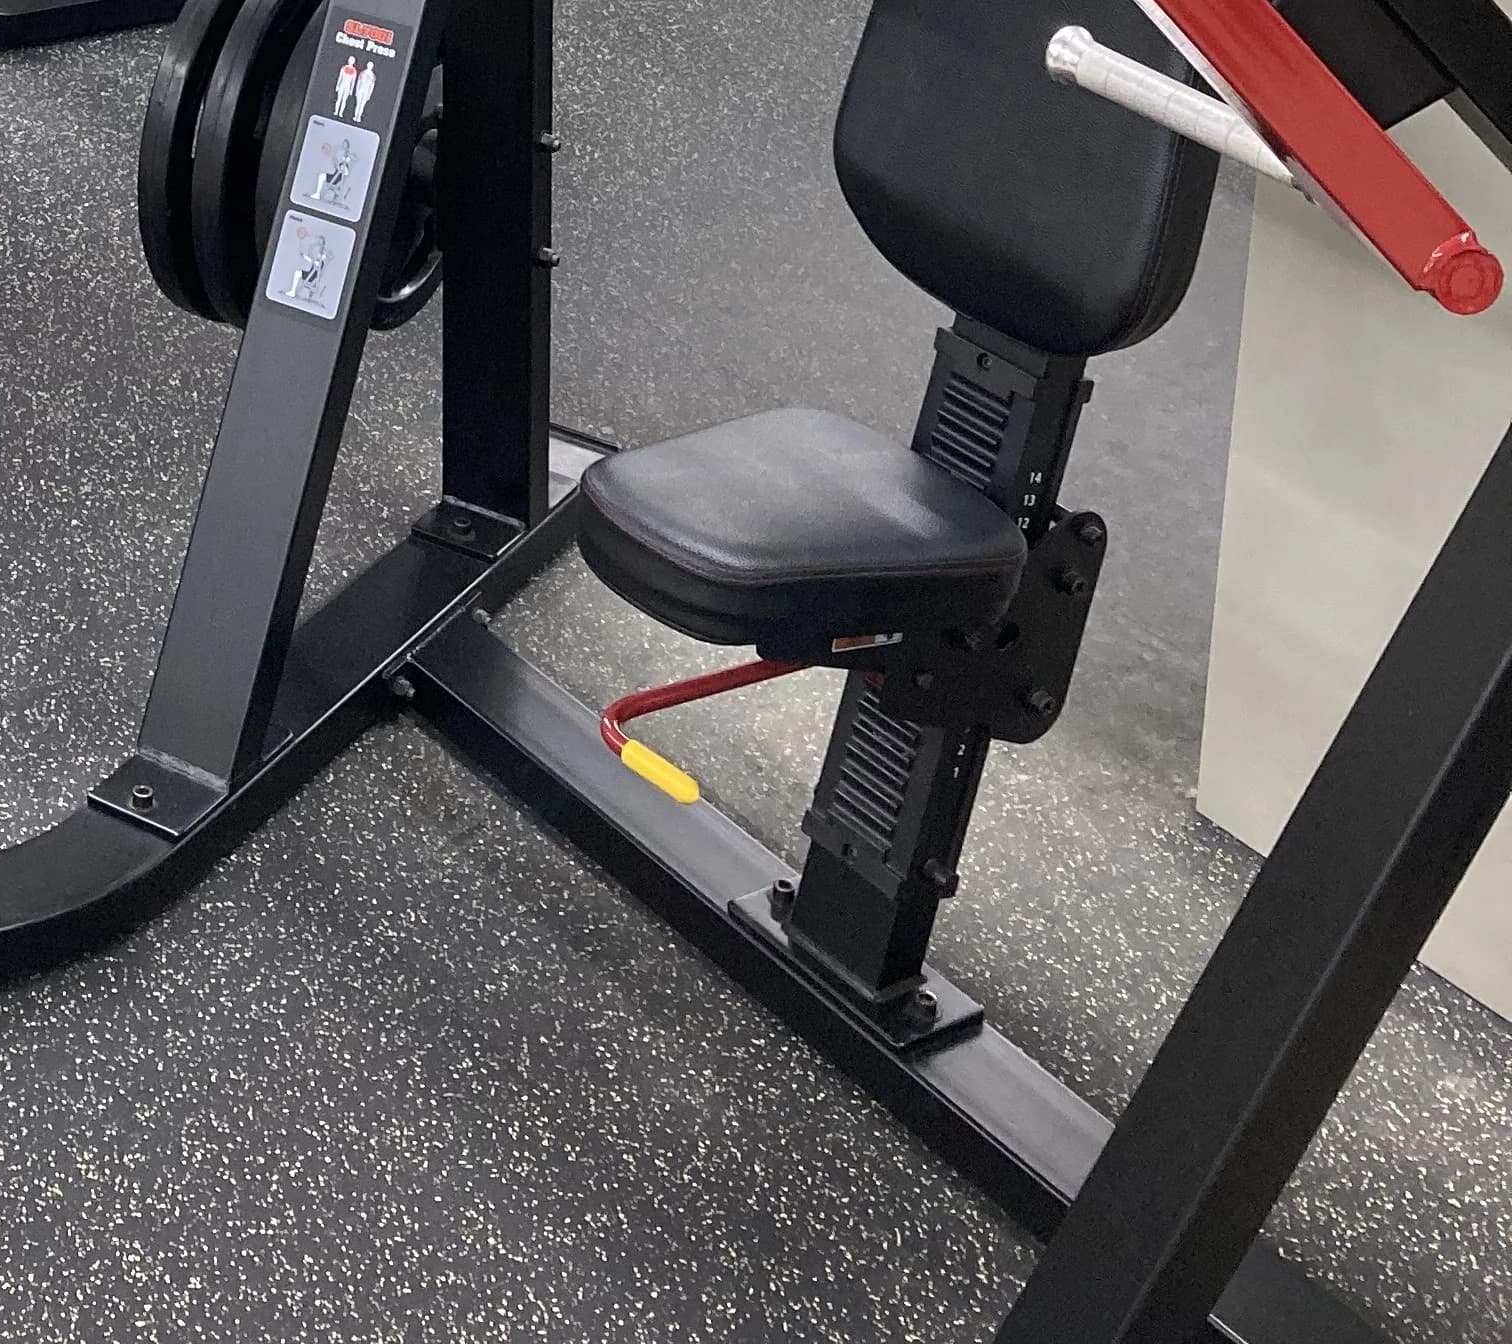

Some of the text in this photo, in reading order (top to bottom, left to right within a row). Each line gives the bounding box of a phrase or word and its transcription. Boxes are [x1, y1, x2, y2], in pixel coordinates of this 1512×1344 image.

[335, 31, 397, 58] Chest Press
[1029, 471, 1043, 485] 14
[1017, 516, 1031, 529] 12
[956, 743, 966, 757] 2
[953, 766, 960, 779] 1
